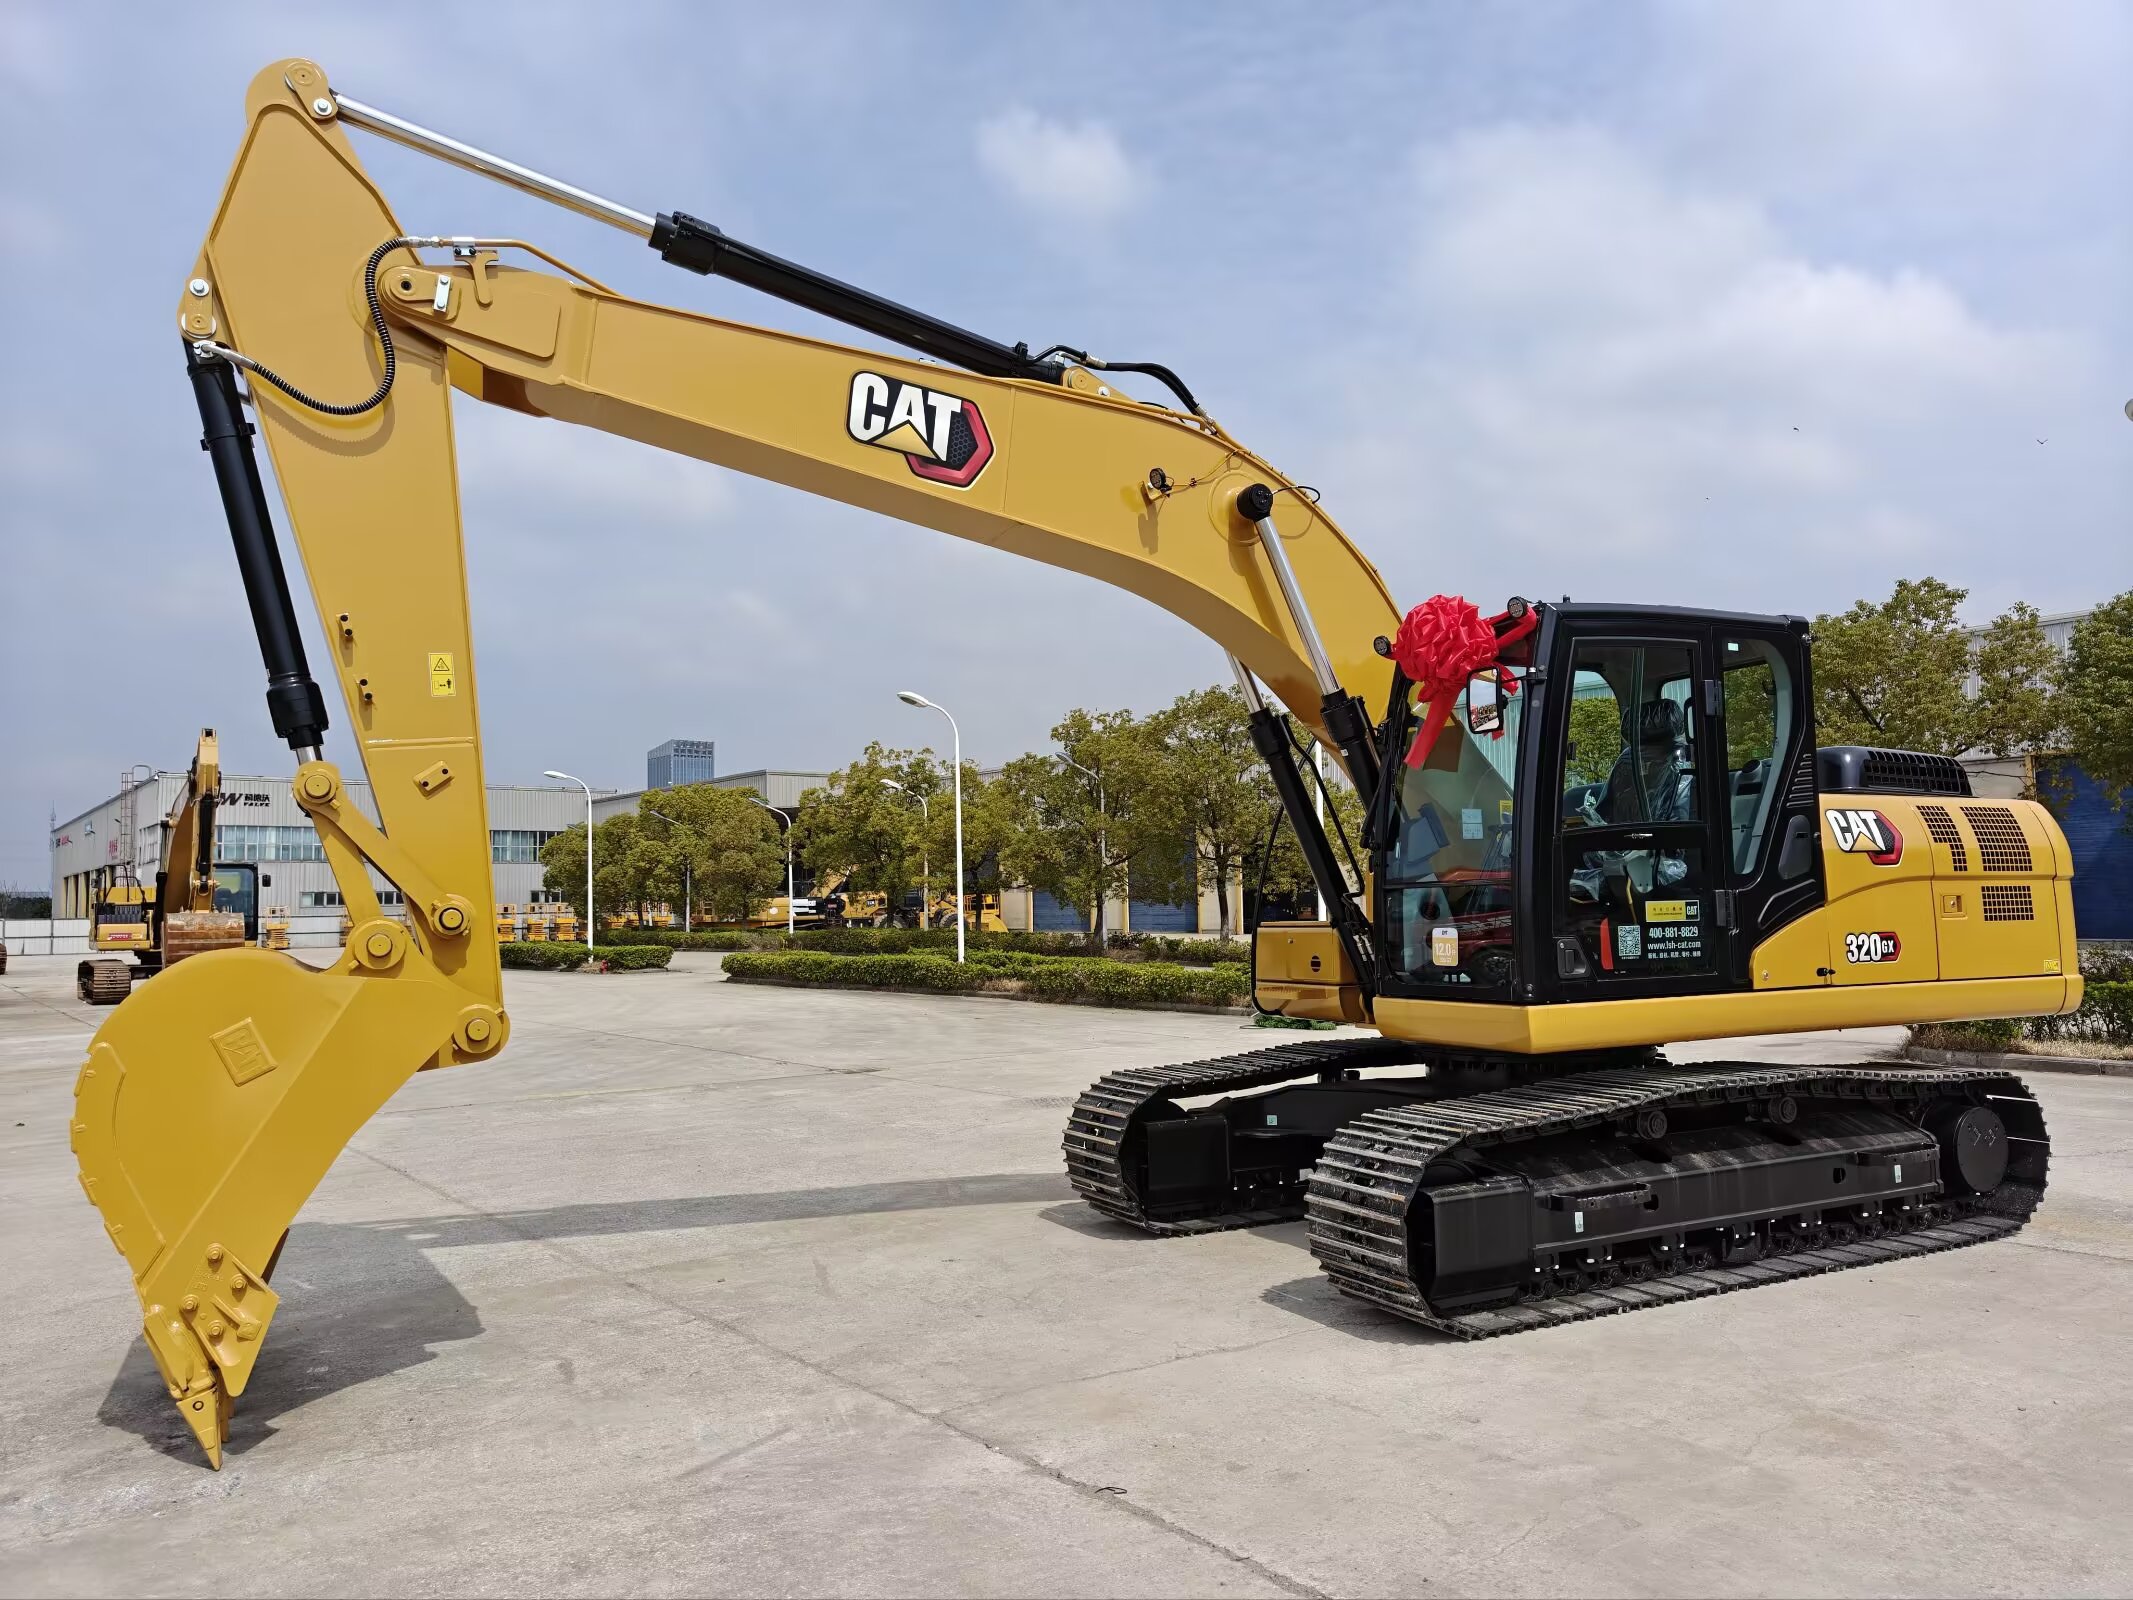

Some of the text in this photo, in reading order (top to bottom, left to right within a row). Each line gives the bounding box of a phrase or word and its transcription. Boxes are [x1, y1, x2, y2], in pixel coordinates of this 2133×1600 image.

[849, 372, 962, 461] CAT
[1825, 809, 1886, 851] CAT
[1686, 905, 1698, 916] CAT
[1649, 926, 1699, 938] 400-881-8829
[1435, 943, 1451, 956] 12.0
[1647, 940, 1701, 951] www.lsh-cat.com
[1846, 933, 1895, 961] 320 GX
